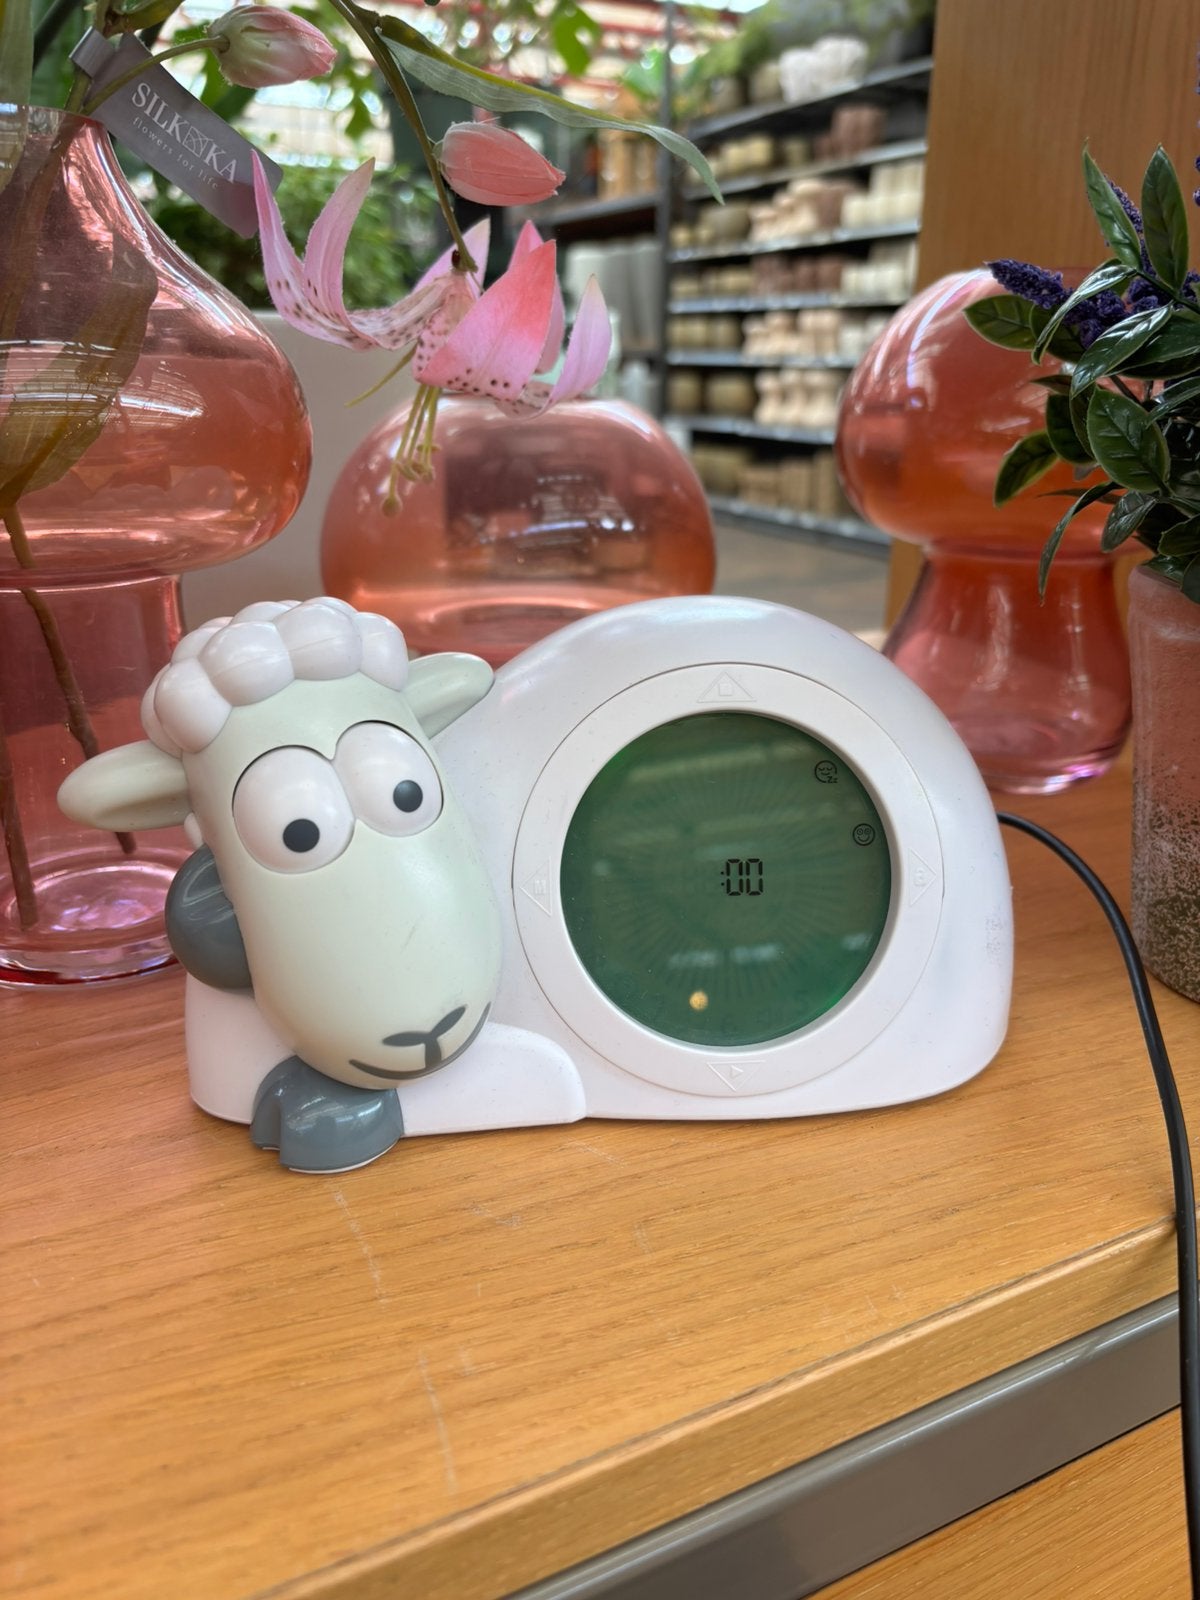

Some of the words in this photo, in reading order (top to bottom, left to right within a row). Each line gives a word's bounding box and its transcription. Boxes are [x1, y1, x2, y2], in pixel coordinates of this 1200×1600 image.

[133, 116, 173, 155] flowers
[177, 154, 194, 171] for
[198, 169, 219, 190] life
